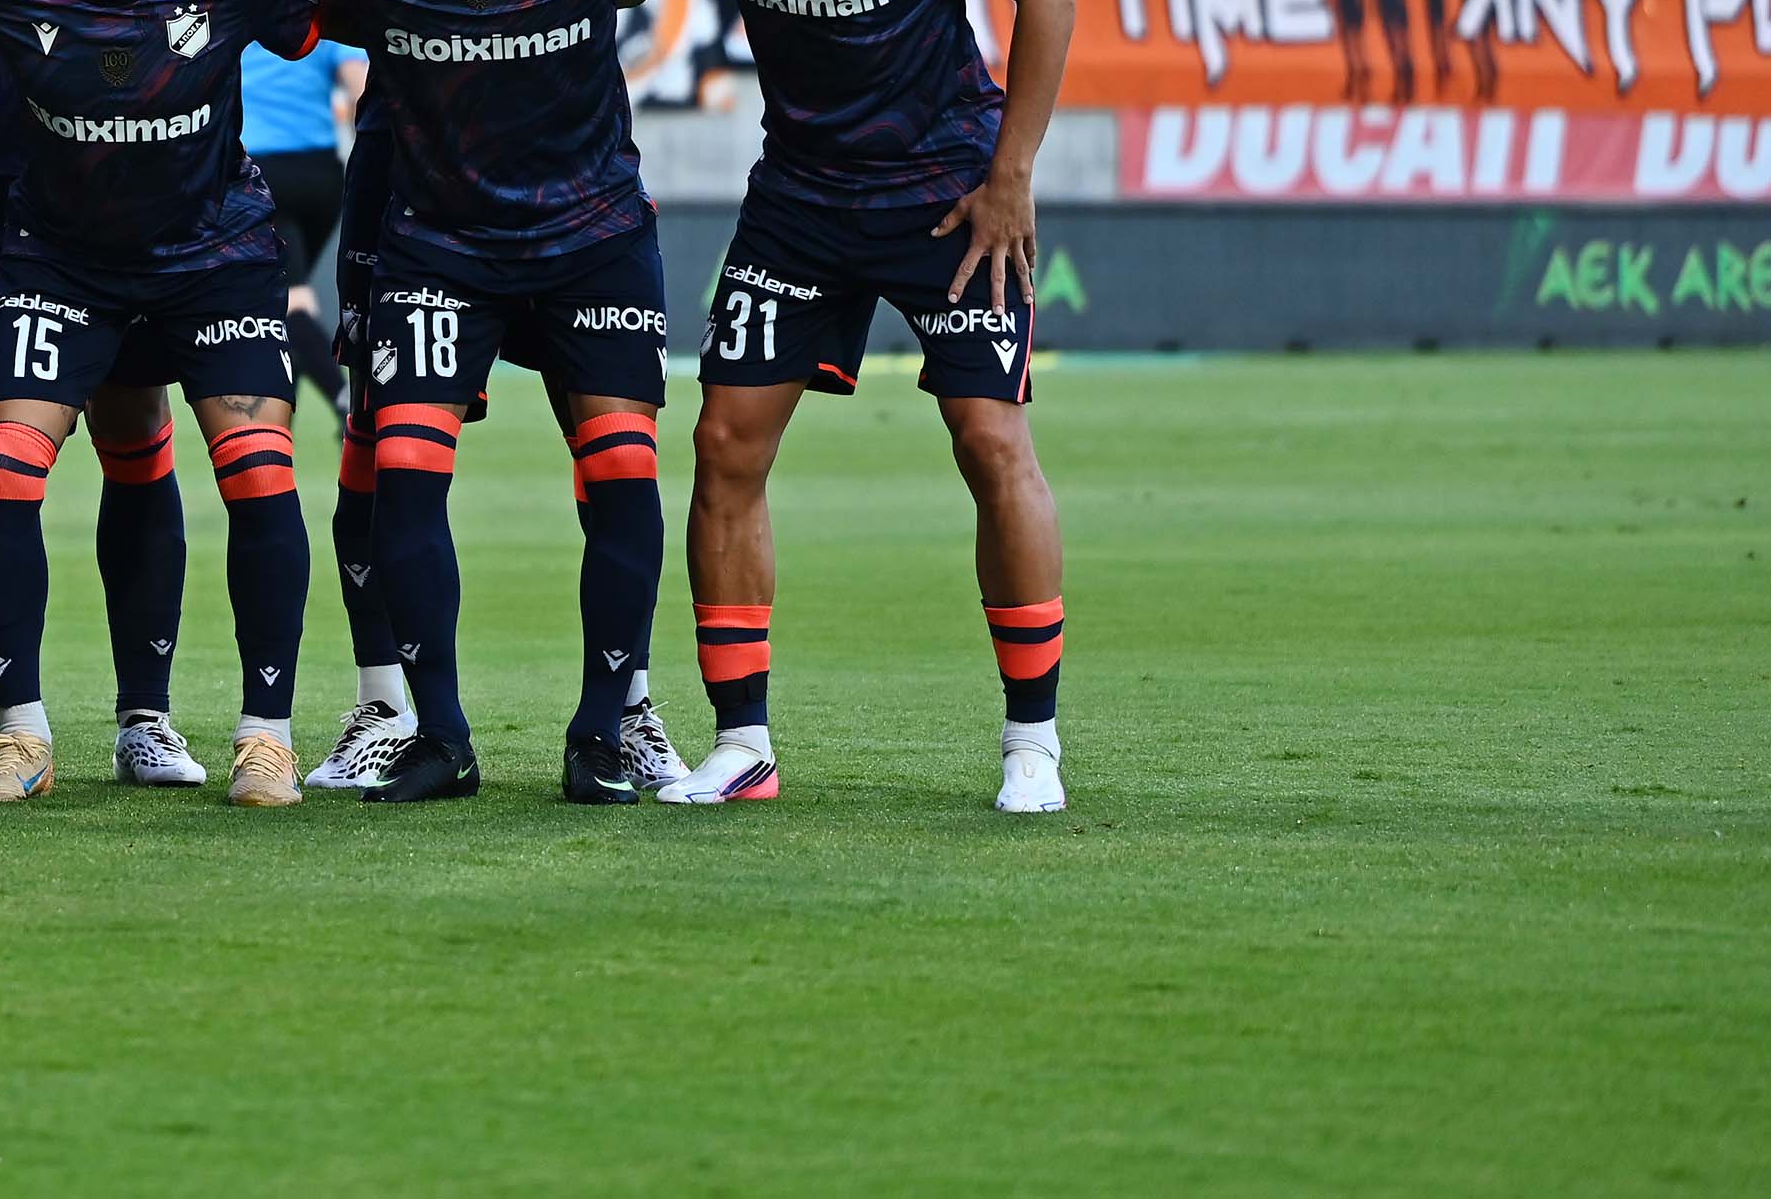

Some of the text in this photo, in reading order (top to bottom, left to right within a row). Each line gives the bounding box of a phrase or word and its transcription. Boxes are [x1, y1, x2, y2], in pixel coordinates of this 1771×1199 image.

[384, 17, 592, 63] Stoiximan
[724, 264, 824, 301] cablenet
[1535, 238, 1661, 317] AEK
[12, 313, 64, 381] 15
[406, 307, 460, 378] 18
[573, 306, 667, 336] NUROFE
[719, 290, 778, 362] 31
